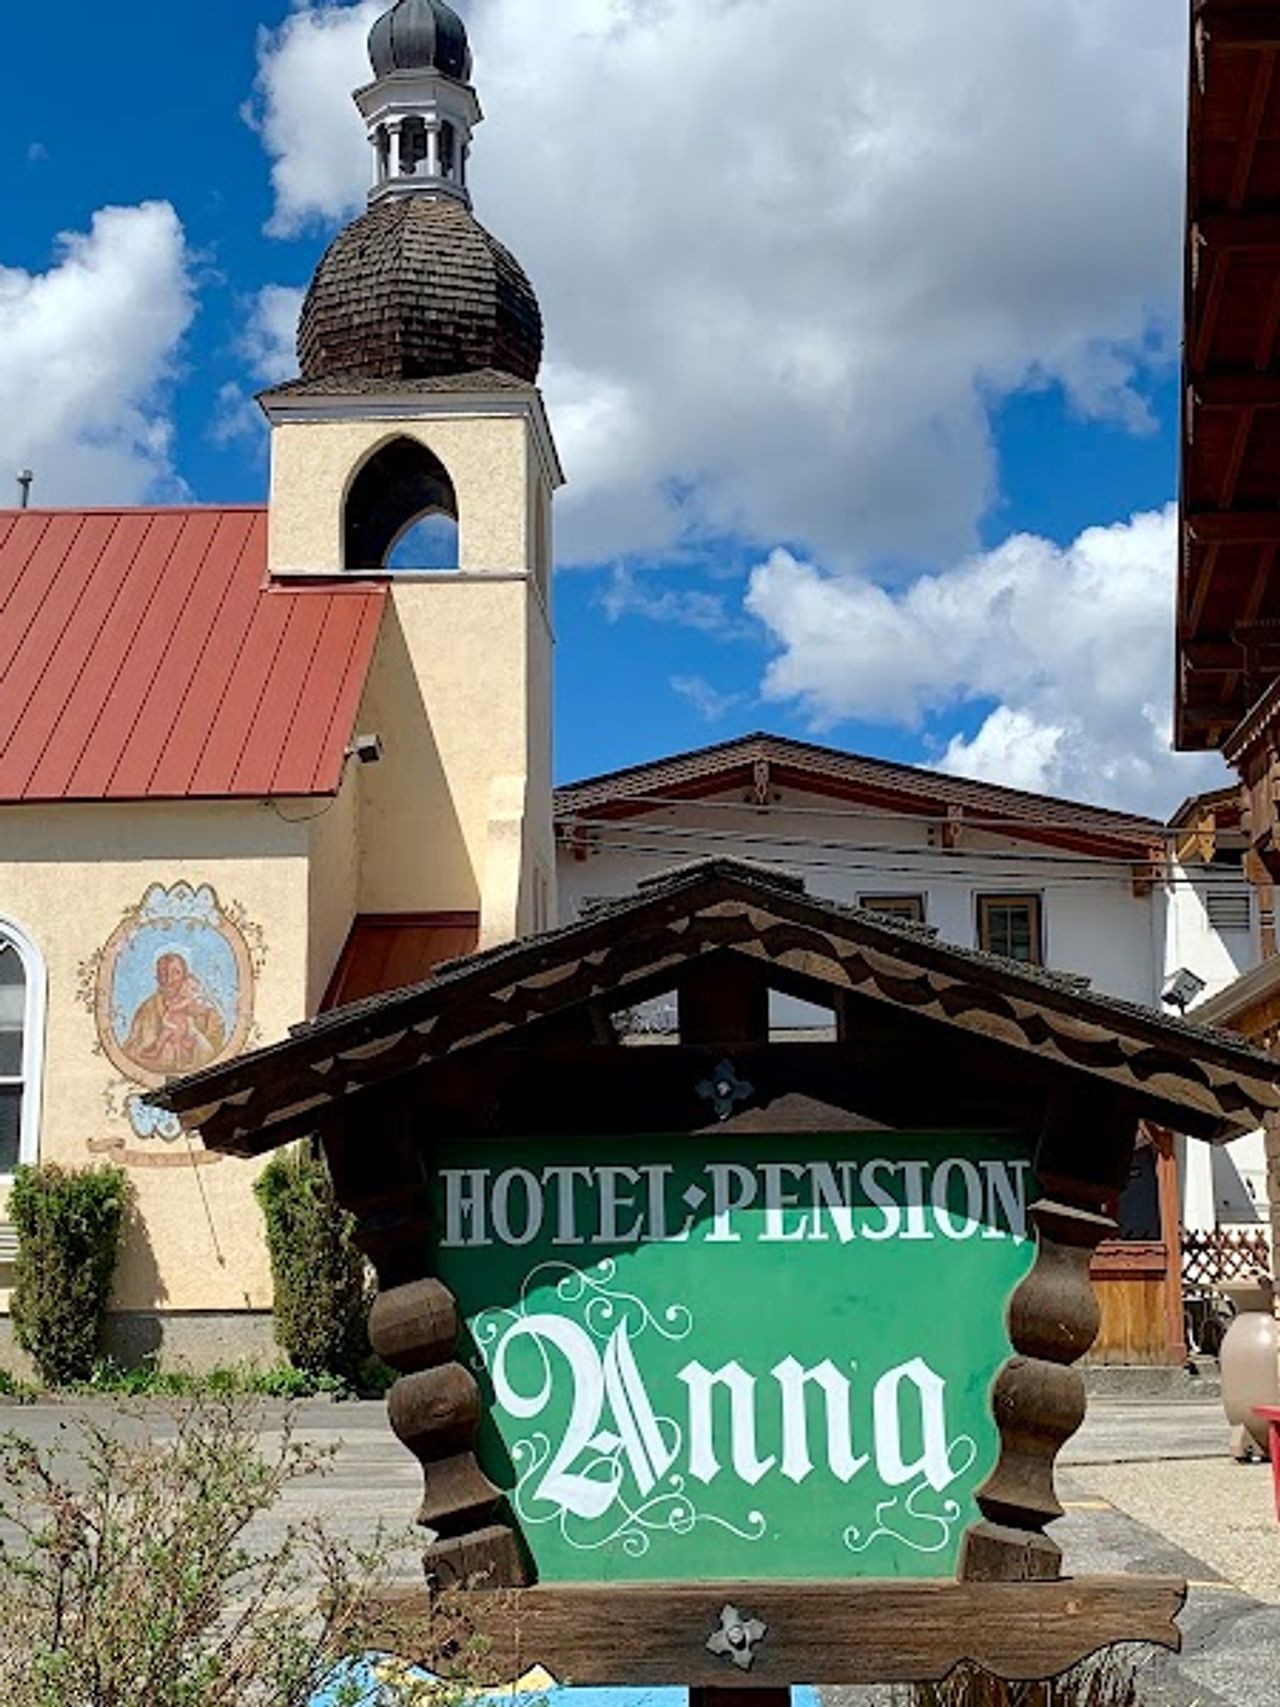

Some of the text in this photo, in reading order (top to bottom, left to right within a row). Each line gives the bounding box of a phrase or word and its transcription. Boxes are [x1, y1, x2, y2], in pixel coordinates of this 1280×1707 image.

[438, 1158, 1030, 1247] HOTEL PENSION
[492, 1313, 958, 1519] Anna
